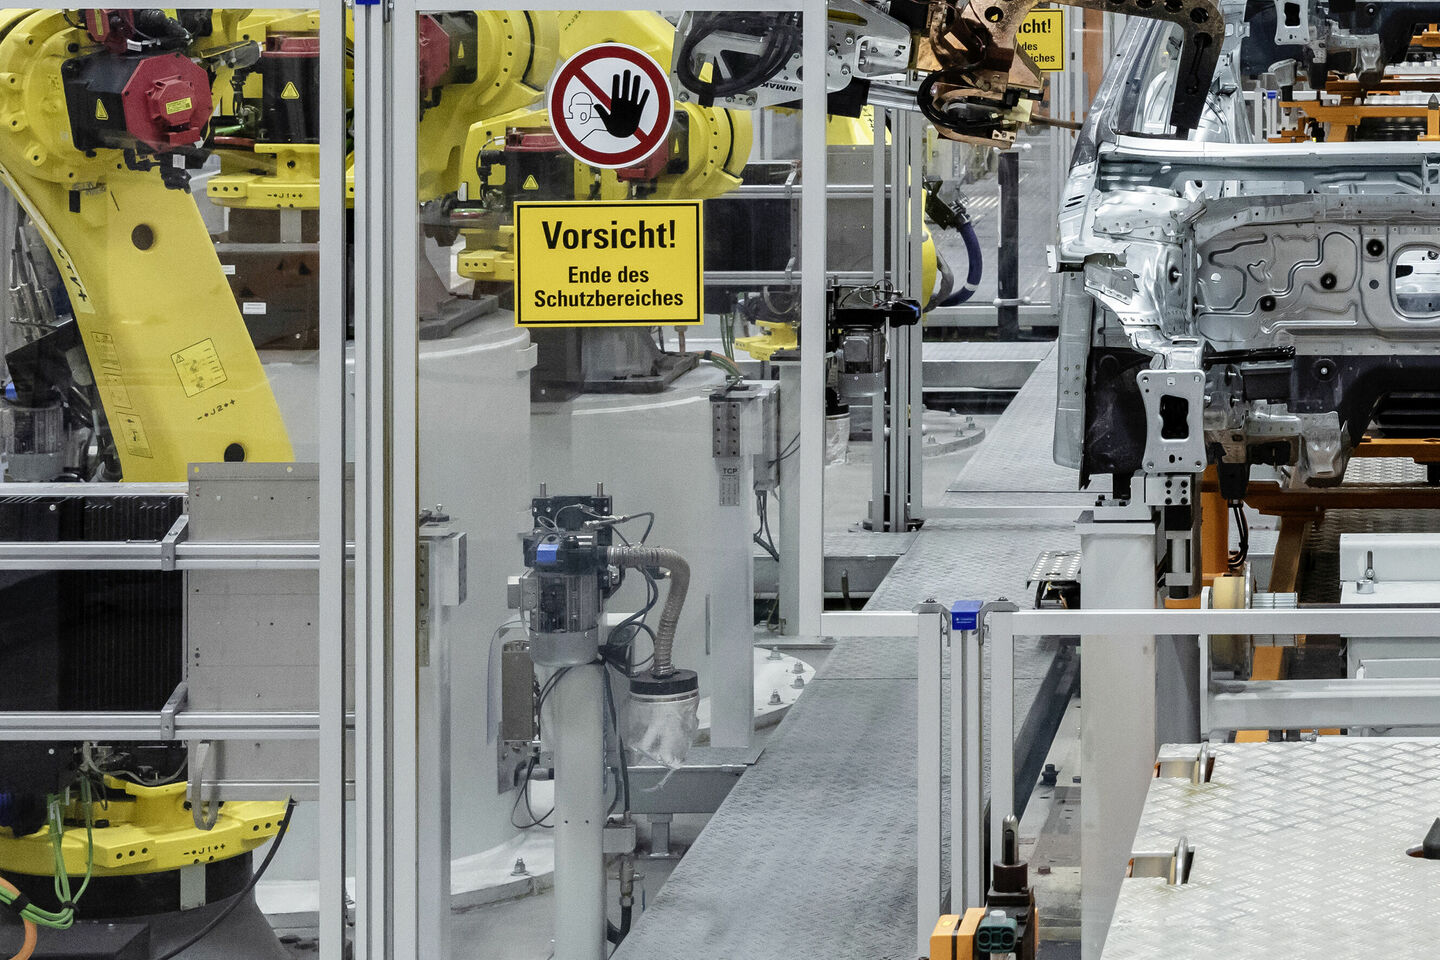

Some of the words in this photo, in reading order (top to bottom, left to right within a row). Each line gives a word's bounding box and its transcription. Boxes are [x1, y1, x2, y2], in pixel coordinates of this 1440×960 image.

[541, 220, 676, 250] Vorsicht!
[568, 266, 612, 284] Ende
[618, 265, 649, 283] des
[534, 289, 684, 308] Schutzbereiches
